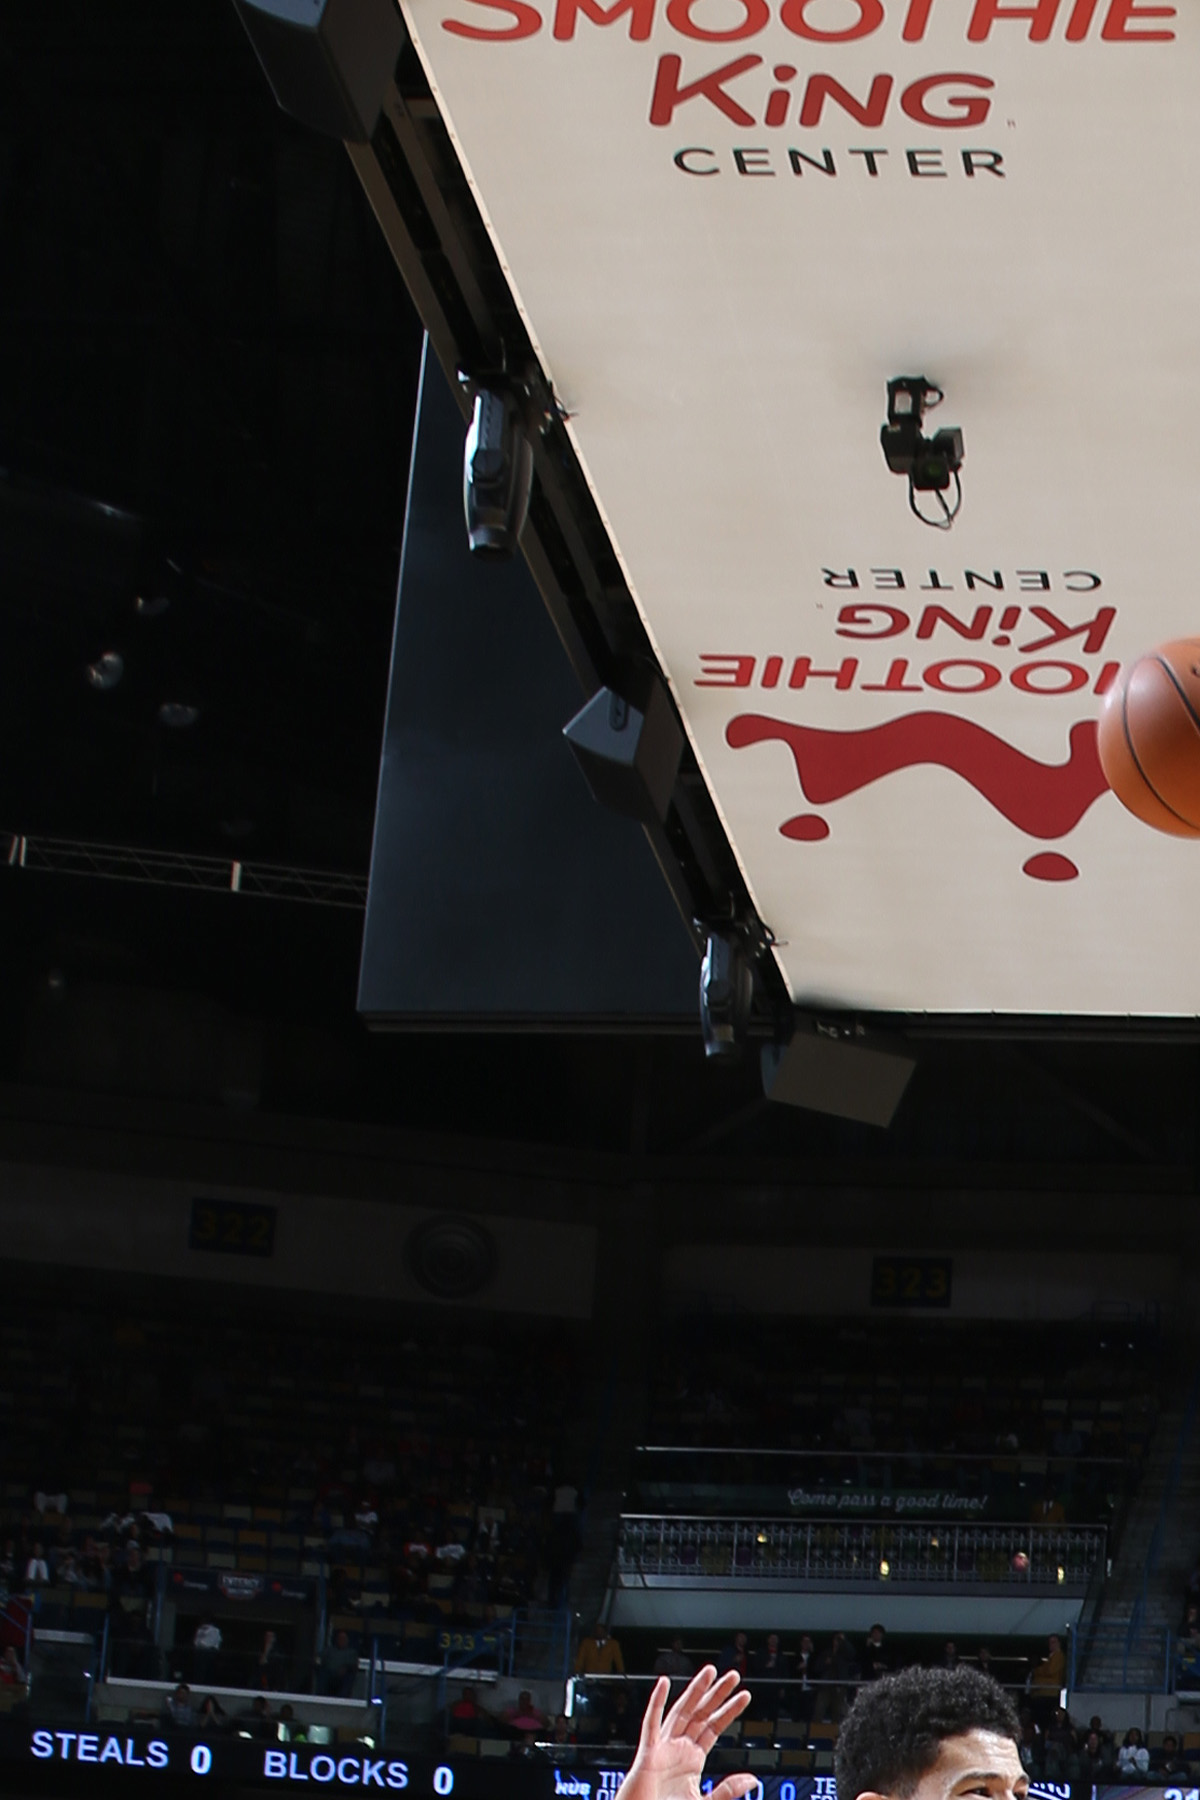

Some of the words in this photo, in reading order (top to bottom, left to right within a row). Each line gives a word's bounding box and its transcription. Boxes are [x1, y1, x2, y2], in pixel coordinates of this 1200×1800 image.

[673, 148, 1005, 178] CENTER
[822, 568, 1102, 591] CENTER
[694, 654, 1119, 697] OOTHIE
[193, 1208, 271, 1248] 322
[876, 1265, 947, 1298] 323
[30, 1731, 168, 1768] STEALS
[190, 1745, 212, 1774] 0
[264, 1750, 408, 1788] BLOCKS
[433, 1766, 454, 1795] 0
[813, 1777, 836, 1794] TE
